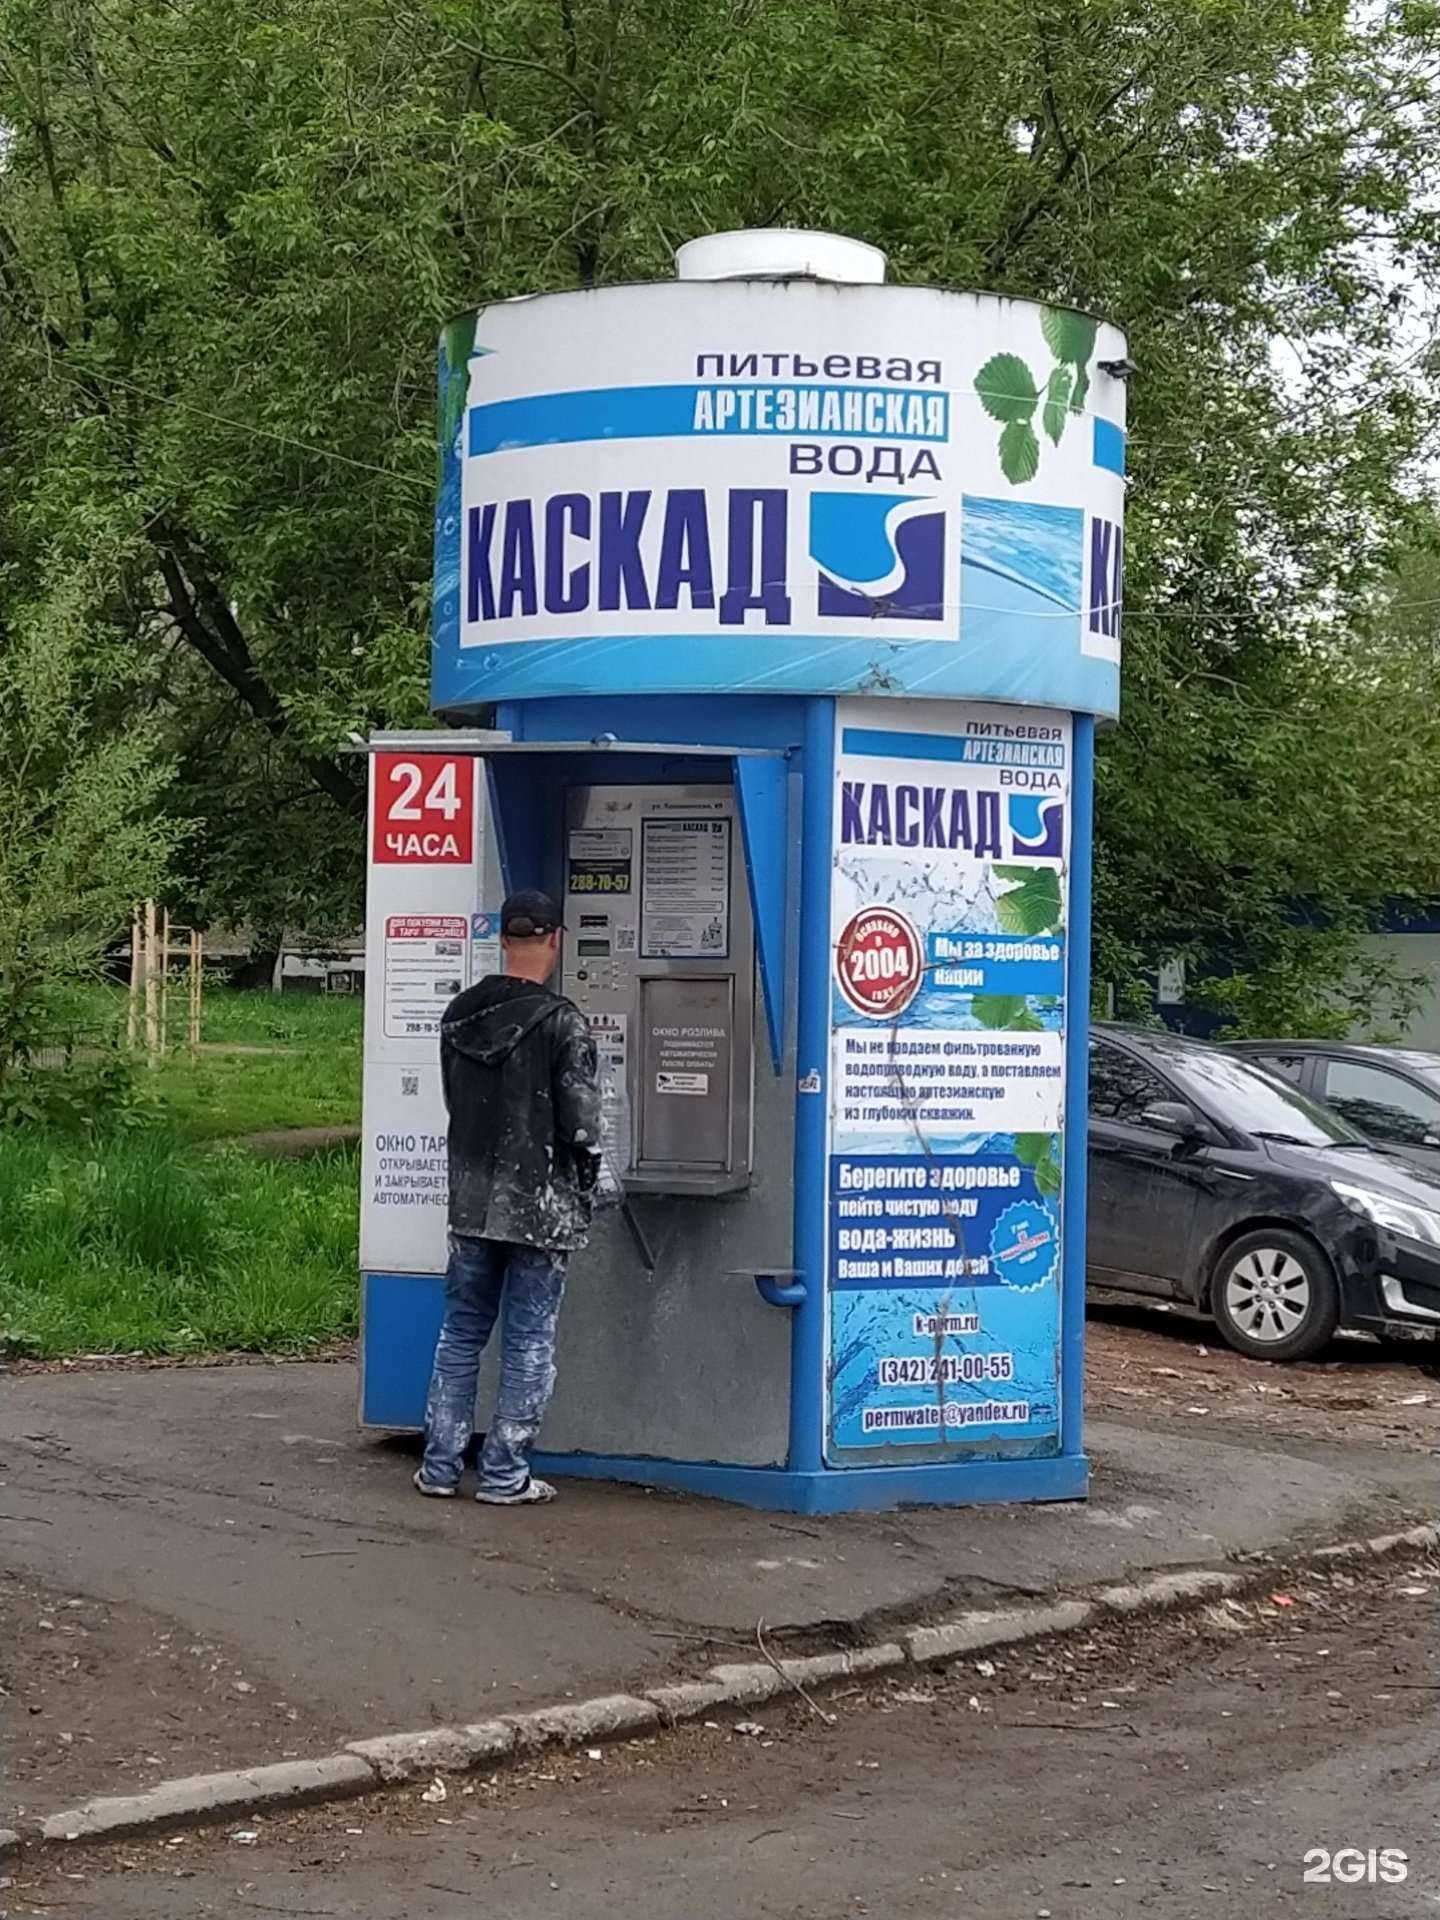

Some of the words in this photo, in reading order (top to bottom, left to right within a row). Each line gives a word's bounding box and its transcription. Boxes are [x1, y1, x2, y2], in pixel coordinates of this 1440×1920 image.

[696, 352, 942, 385] питьевая
[693, 388, 946, 437] АРТЕЗИАНСКАЯ
[789, 444, 943, 483] ВОДА
[467, 488, 791, 625] КАСКАД
[966, 721, 1062, 740] питьевая
[963, 740, 1063, 766] АРТЕЗИАНСКАЯ
[388, 762, 461, 820] 24
[1000, 769, 1061, 791] ВОДА
[841, 781, 1002, 859] КАСКАД
[386, 833, 460, 857] ЧАСА
[935, 937, 962, 957] Мы
[964, 941, 983, 958] за
[985, 942, 1060, 962] здоровье
[850, 946, 909, 982] 2004
[934, 968, 984, 988] нации
[846, 1038, 867, 1054] Мы
[870, 1042, 884, 1054] не
[943, 1041, 1041, 1057] фильтрованную
[982, 1065, 988, 1077] а
[991, 1065, 1061, 1078] поставляем
[919, 1086, 1005, 1100] артезианскую
[845, 1108, 860, 1120] из
[376, 1135, 415, 1152] ОКНО
[420, 1135, 448, 1152] ТАР
[379, 1158, 449, 1172] ОТКРЫВАЕТС
[375, 1175, 381, 1187] И
[385, 1175, 447, 1188] ЗАКРЫВАЕТ
[839, 1163, 926, 1191] Берегите
[930, 1166, 1020, 1191] здоровье
[373, 1192, 449, 1206] АВТОМАТИЧЕС
[839, 1197, 883, 1217] пейте
[885, 1199, 940, 1217] чистую
[838, 1259, 880, 1279] Ваша
[882, 1262, 892, 1278] и
[894, 1258, 943, 1278] Ваших
[881, 1359, 925, 1383] (342)
[930, 1356, 1011, 1380] 241-00-55
[865, 1403, 1028, 1429] permwater@yandex.ru
